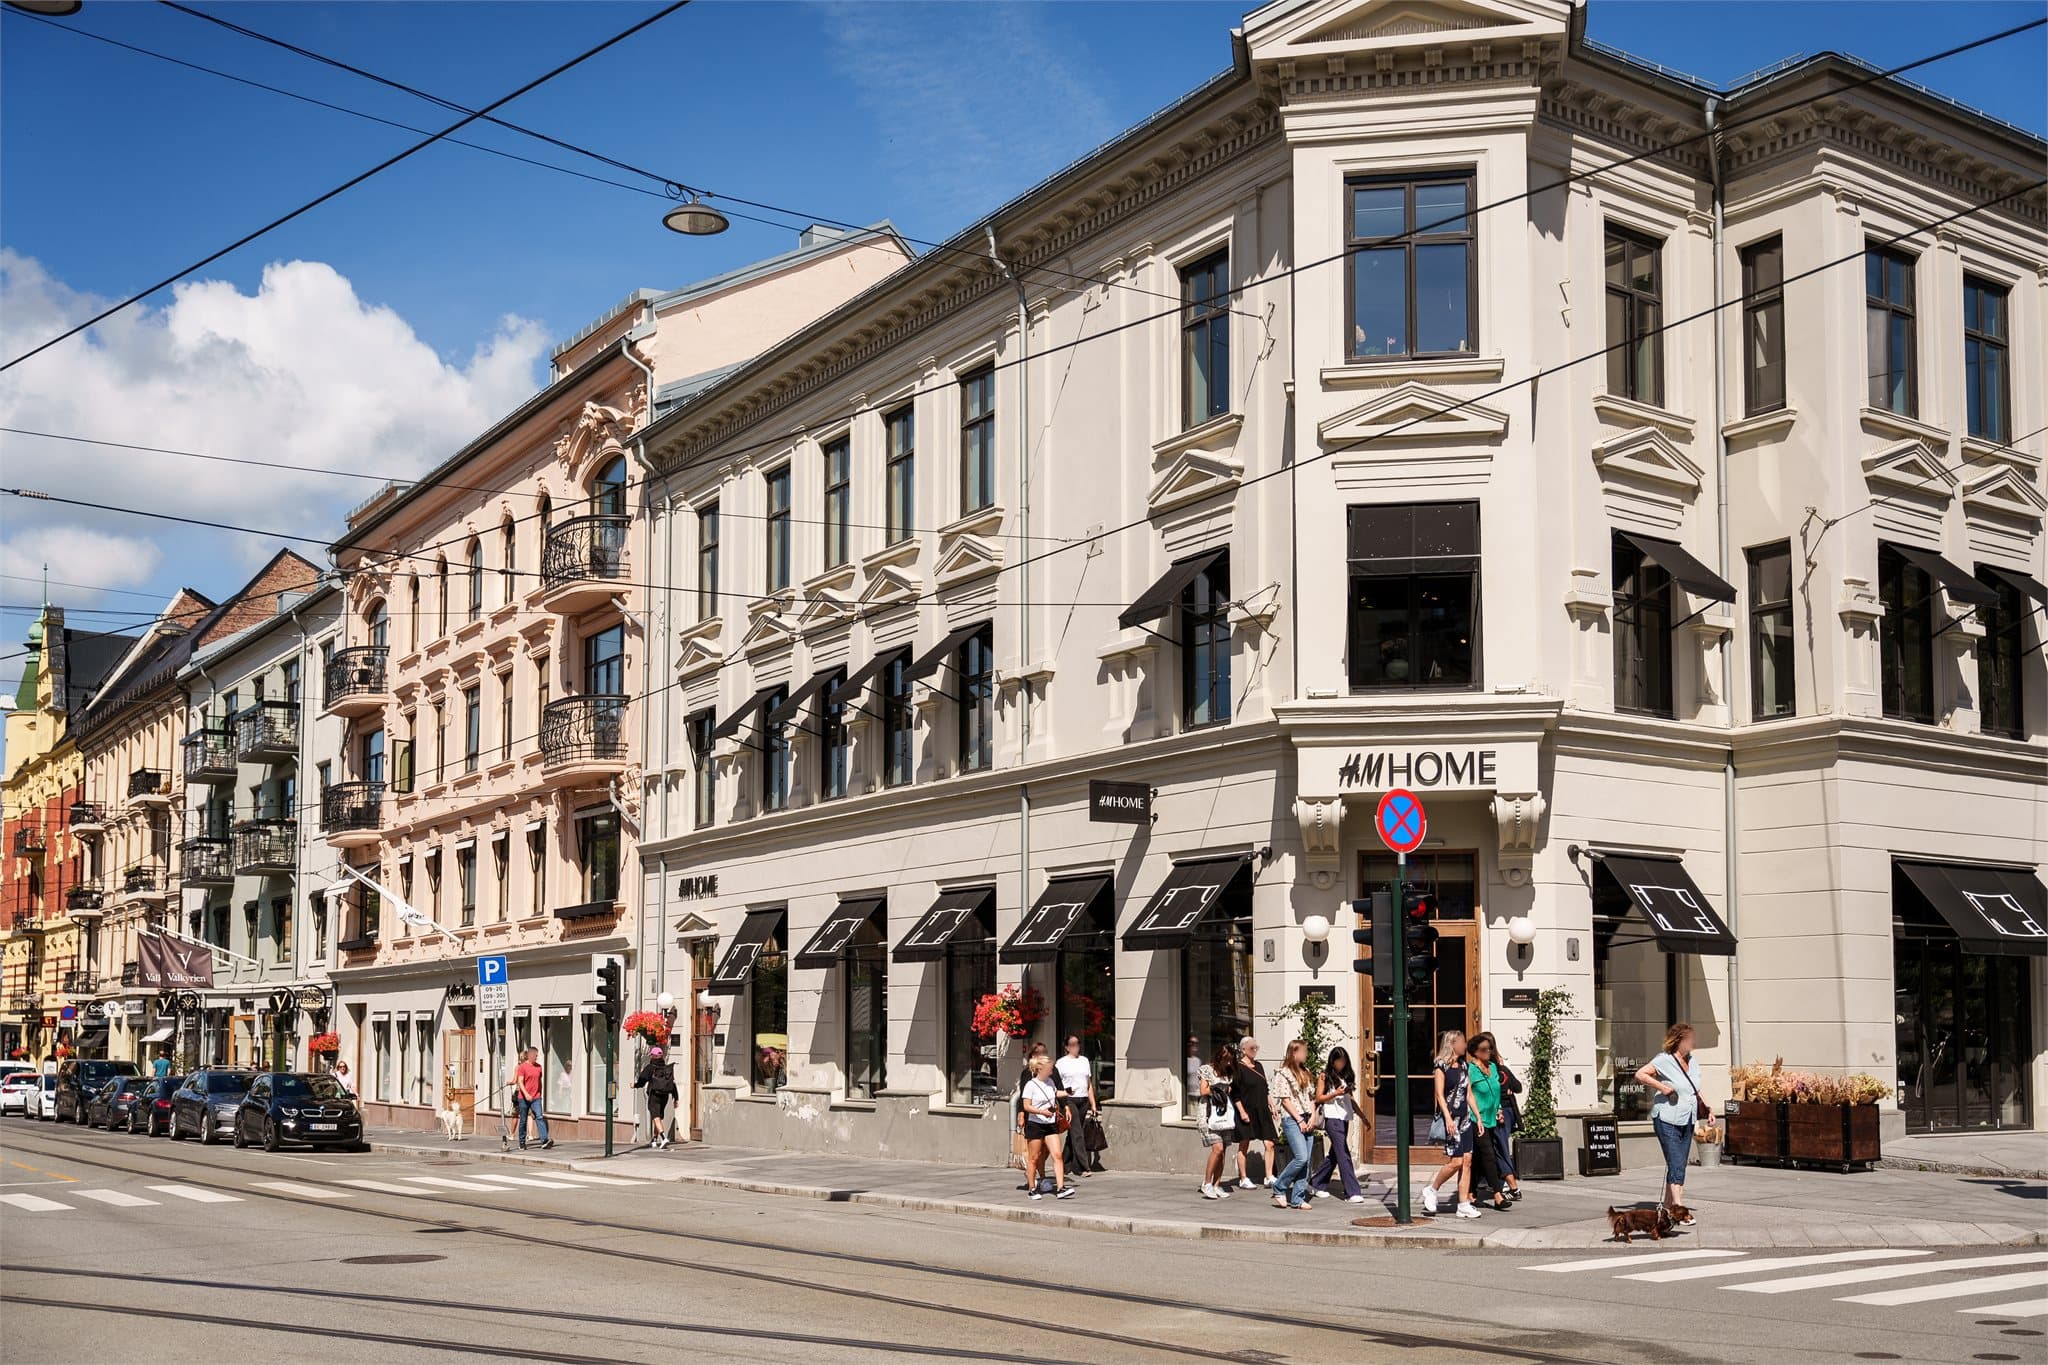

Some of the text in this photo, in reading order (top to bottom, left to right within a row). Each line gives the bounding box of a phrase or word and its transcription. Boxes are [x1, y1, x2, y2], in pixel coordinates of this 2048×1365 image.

[1388, 750, 1497, 787] HOME
[1112, 796, 1145, 810] HOME
[177, 950, 193, 970] V
[166, 972, 206, 984] Valkyrien
[485, 960, 500, 982] P
